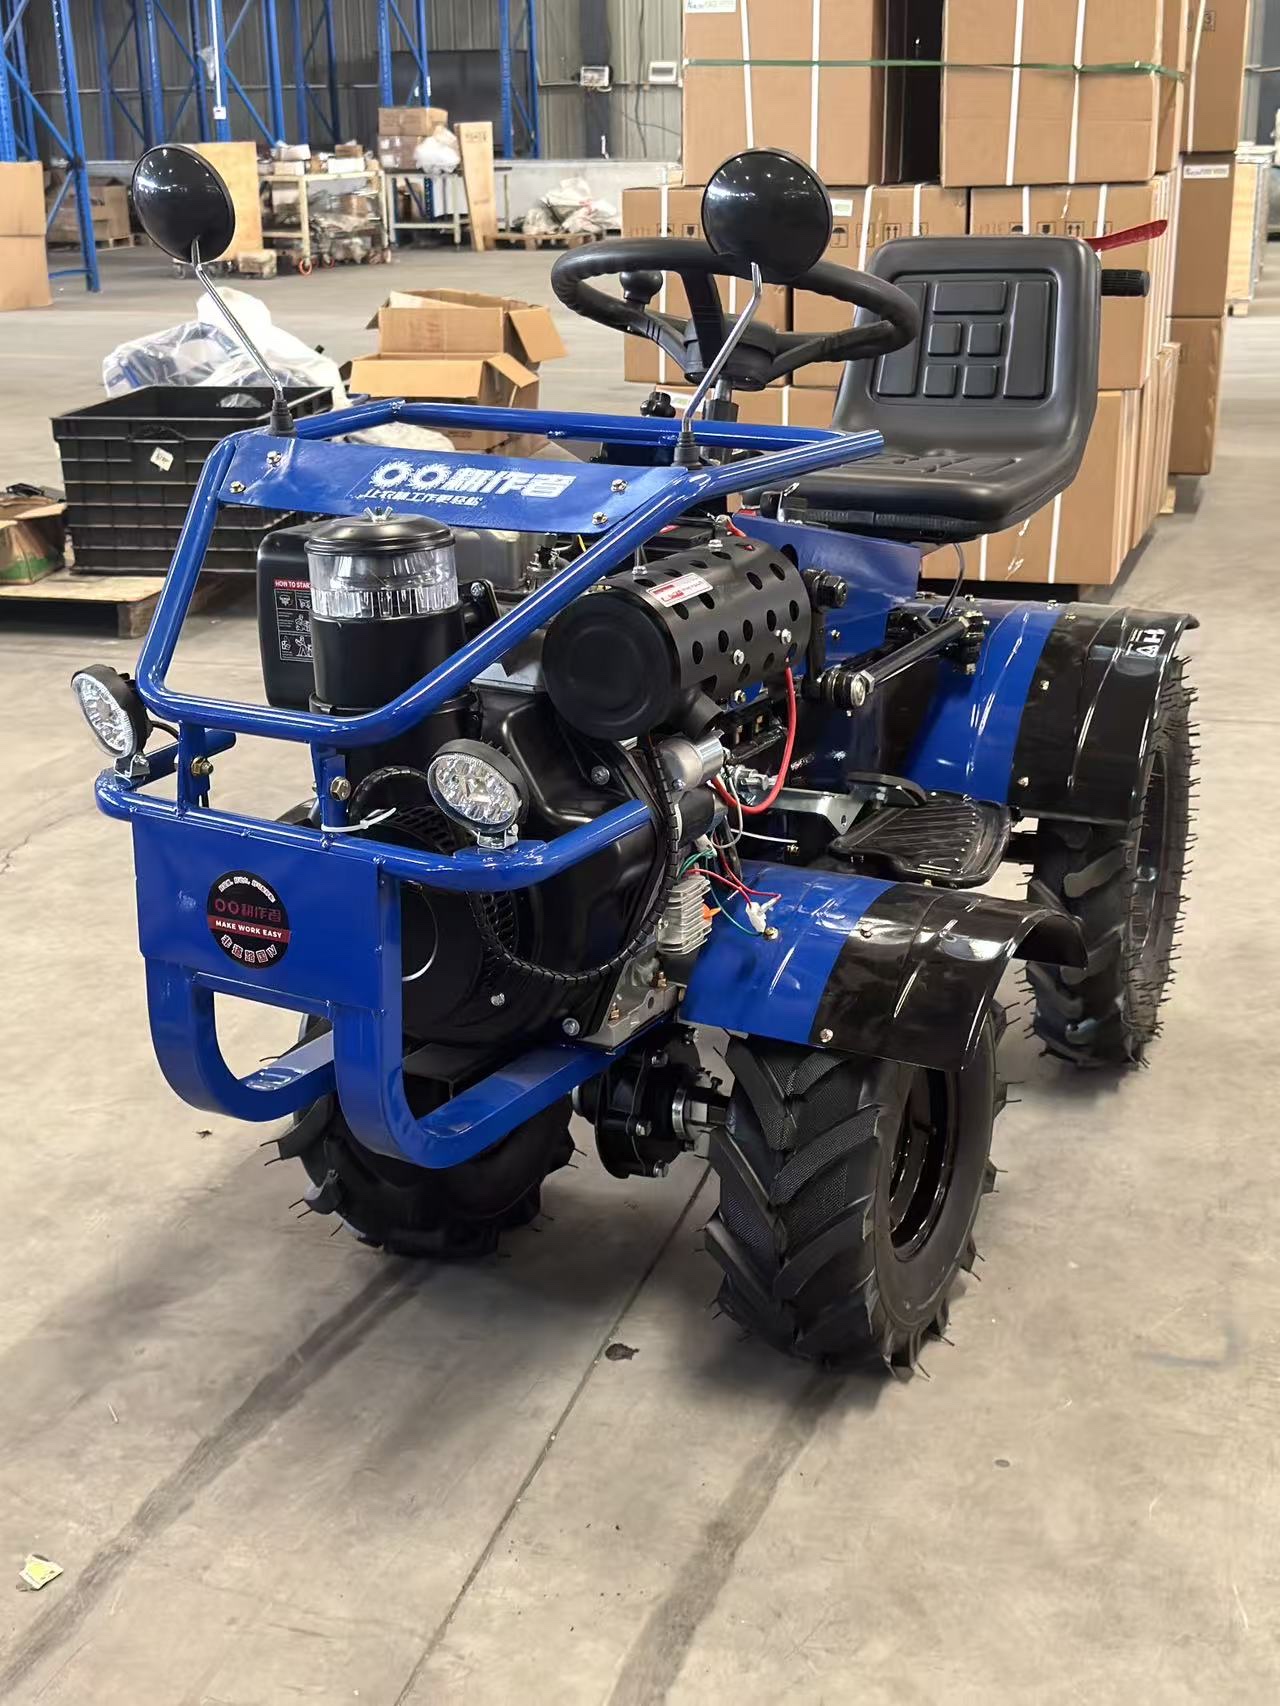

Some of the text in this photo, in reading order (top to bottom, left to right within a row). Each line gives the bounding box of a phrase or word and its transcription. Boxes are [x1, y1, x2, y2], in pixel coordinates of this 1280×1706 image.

[275, 580, 288, 588] HOW
[215, 920, 282, 938] MAKE WORK EASY
